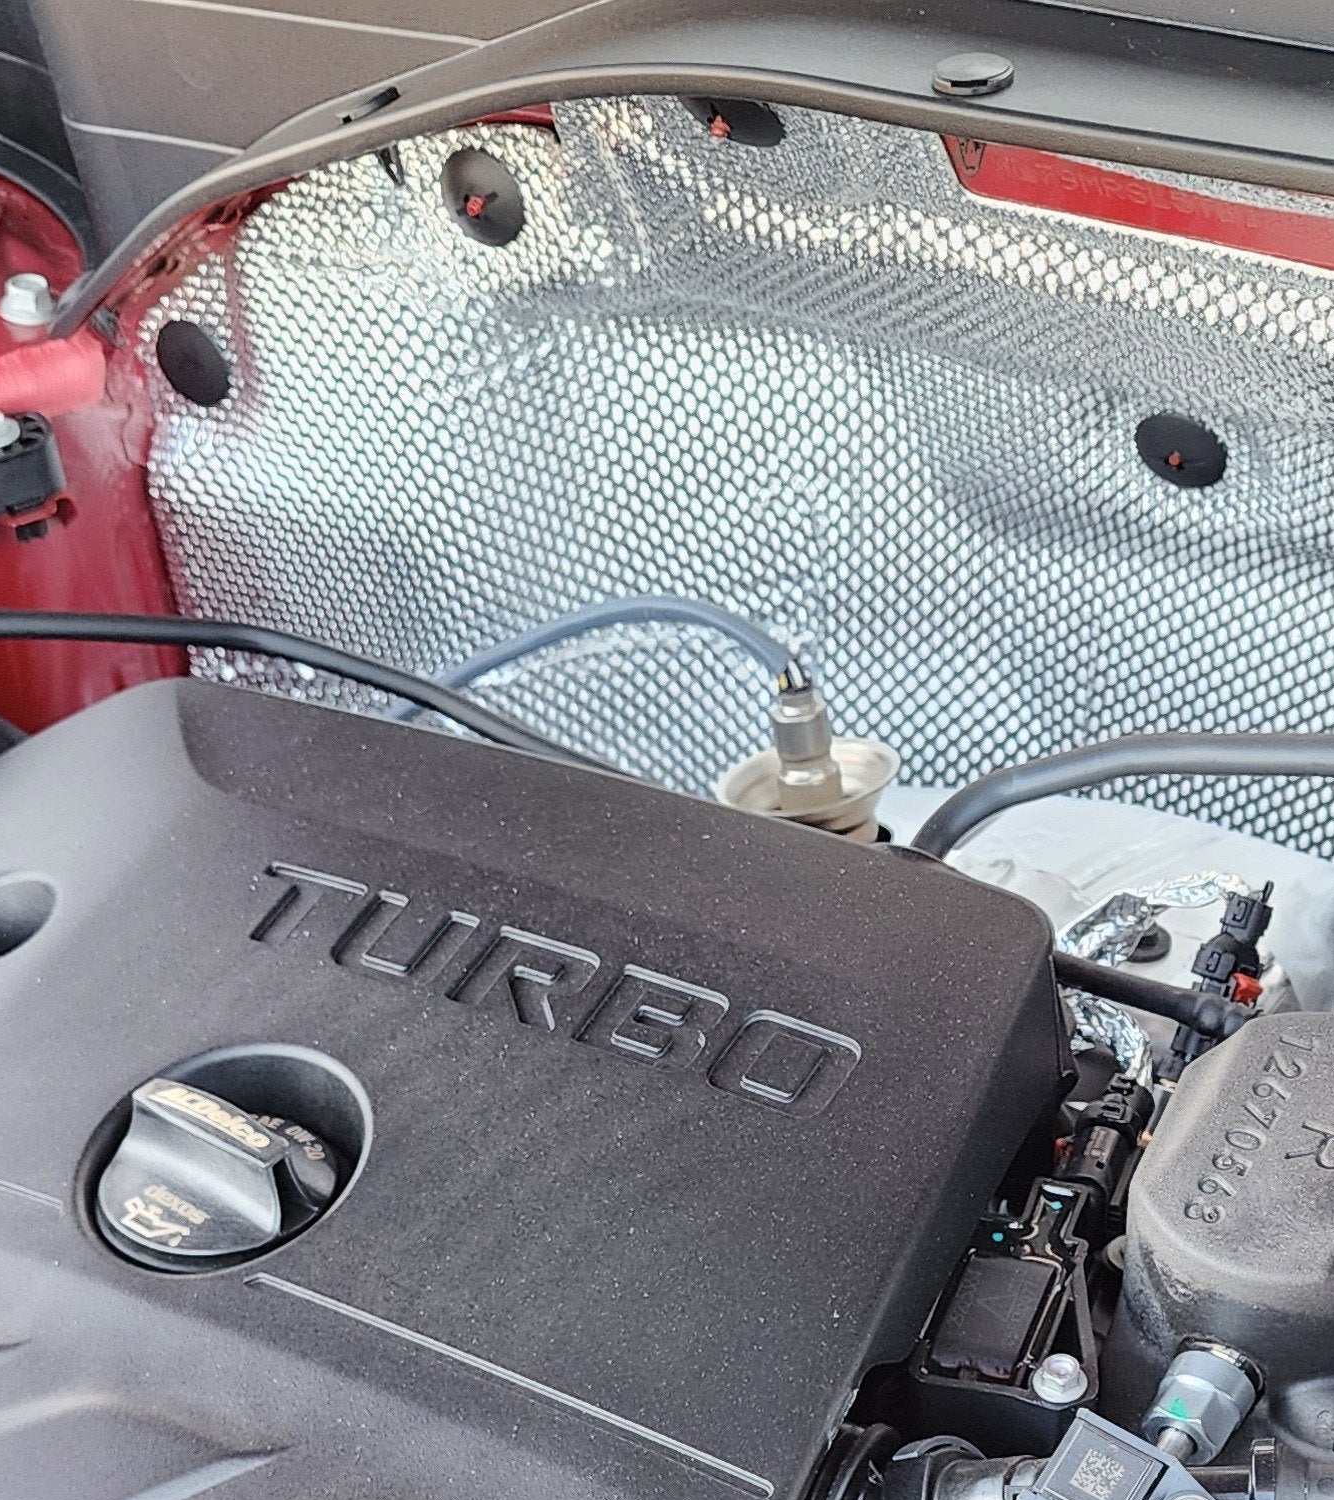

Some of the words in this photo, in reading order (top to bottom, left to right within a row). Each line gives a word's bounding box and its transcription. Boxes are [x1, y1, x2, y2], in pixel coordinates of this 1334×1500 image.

[247, 860, 864, 1118] TURBO
[143, 1184, 212, 1226] dexos
[1184, 1035, 1313, 1224] 12670563
